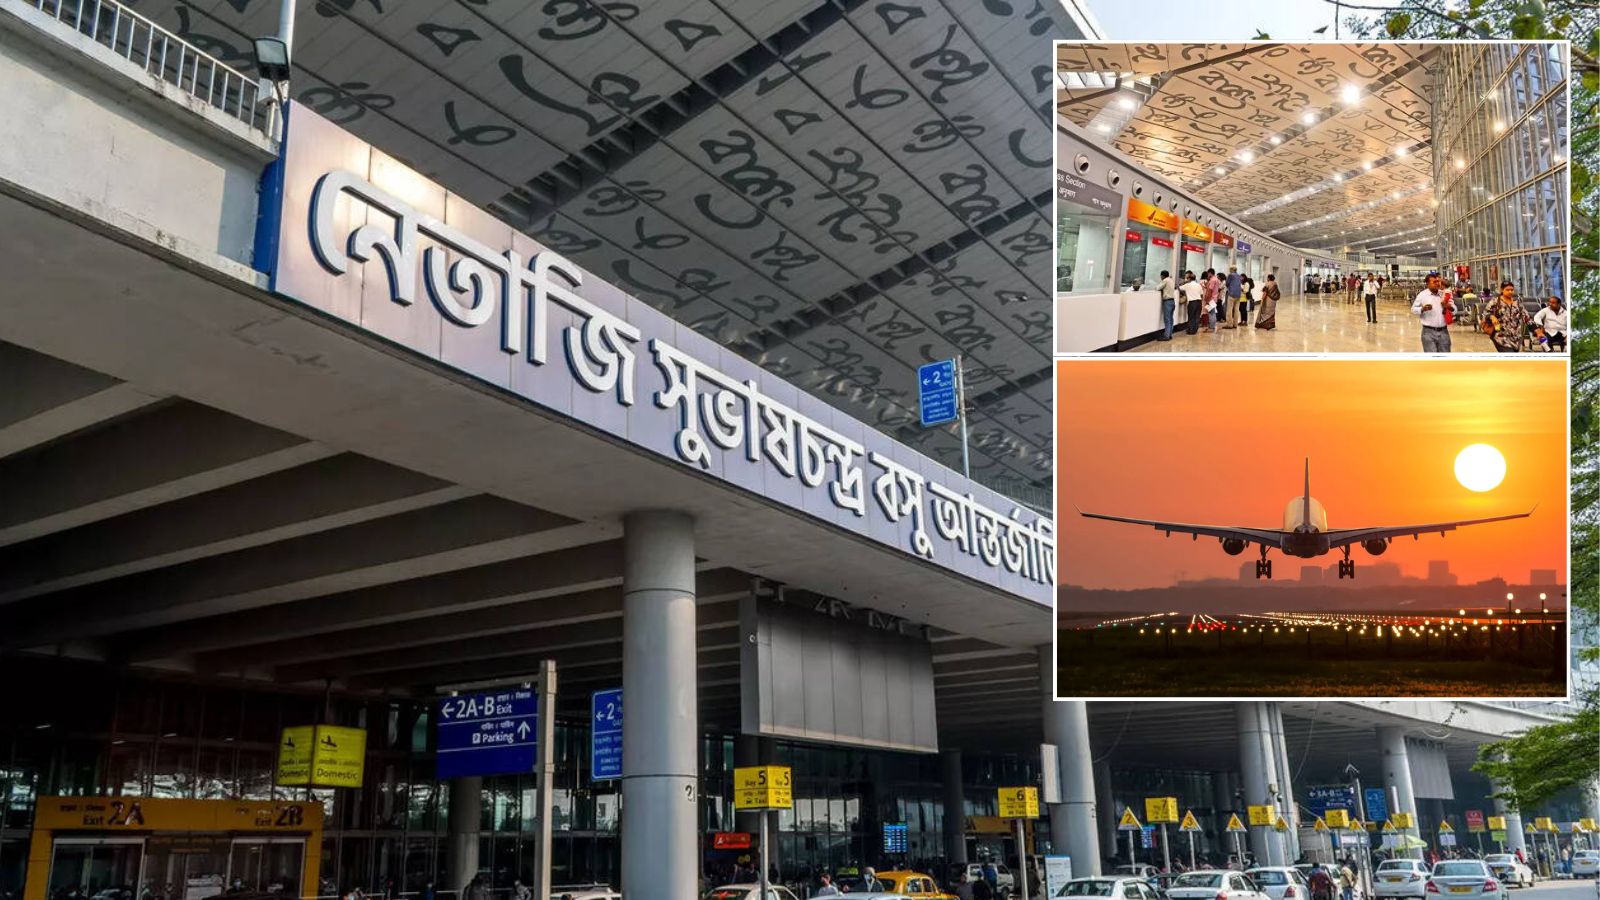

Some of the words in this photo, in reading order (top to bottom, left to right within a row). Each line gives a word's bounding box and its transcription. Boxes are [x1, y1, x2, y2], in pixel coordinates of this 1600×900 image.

[308, 170, 641, 407] নেতাজি
[869, 451, 935, 559] বসু
[456, 697, 495, 718] 2A-B
[496, 704, 513, 714] Exit
[606, 702, 615, 720] 2
[482, 732, 514, 744] Parking
[317, 768, 358, 780] Domestic
[758, 770, 766, 785] 5
[108, 801, 145, 826] 2A
